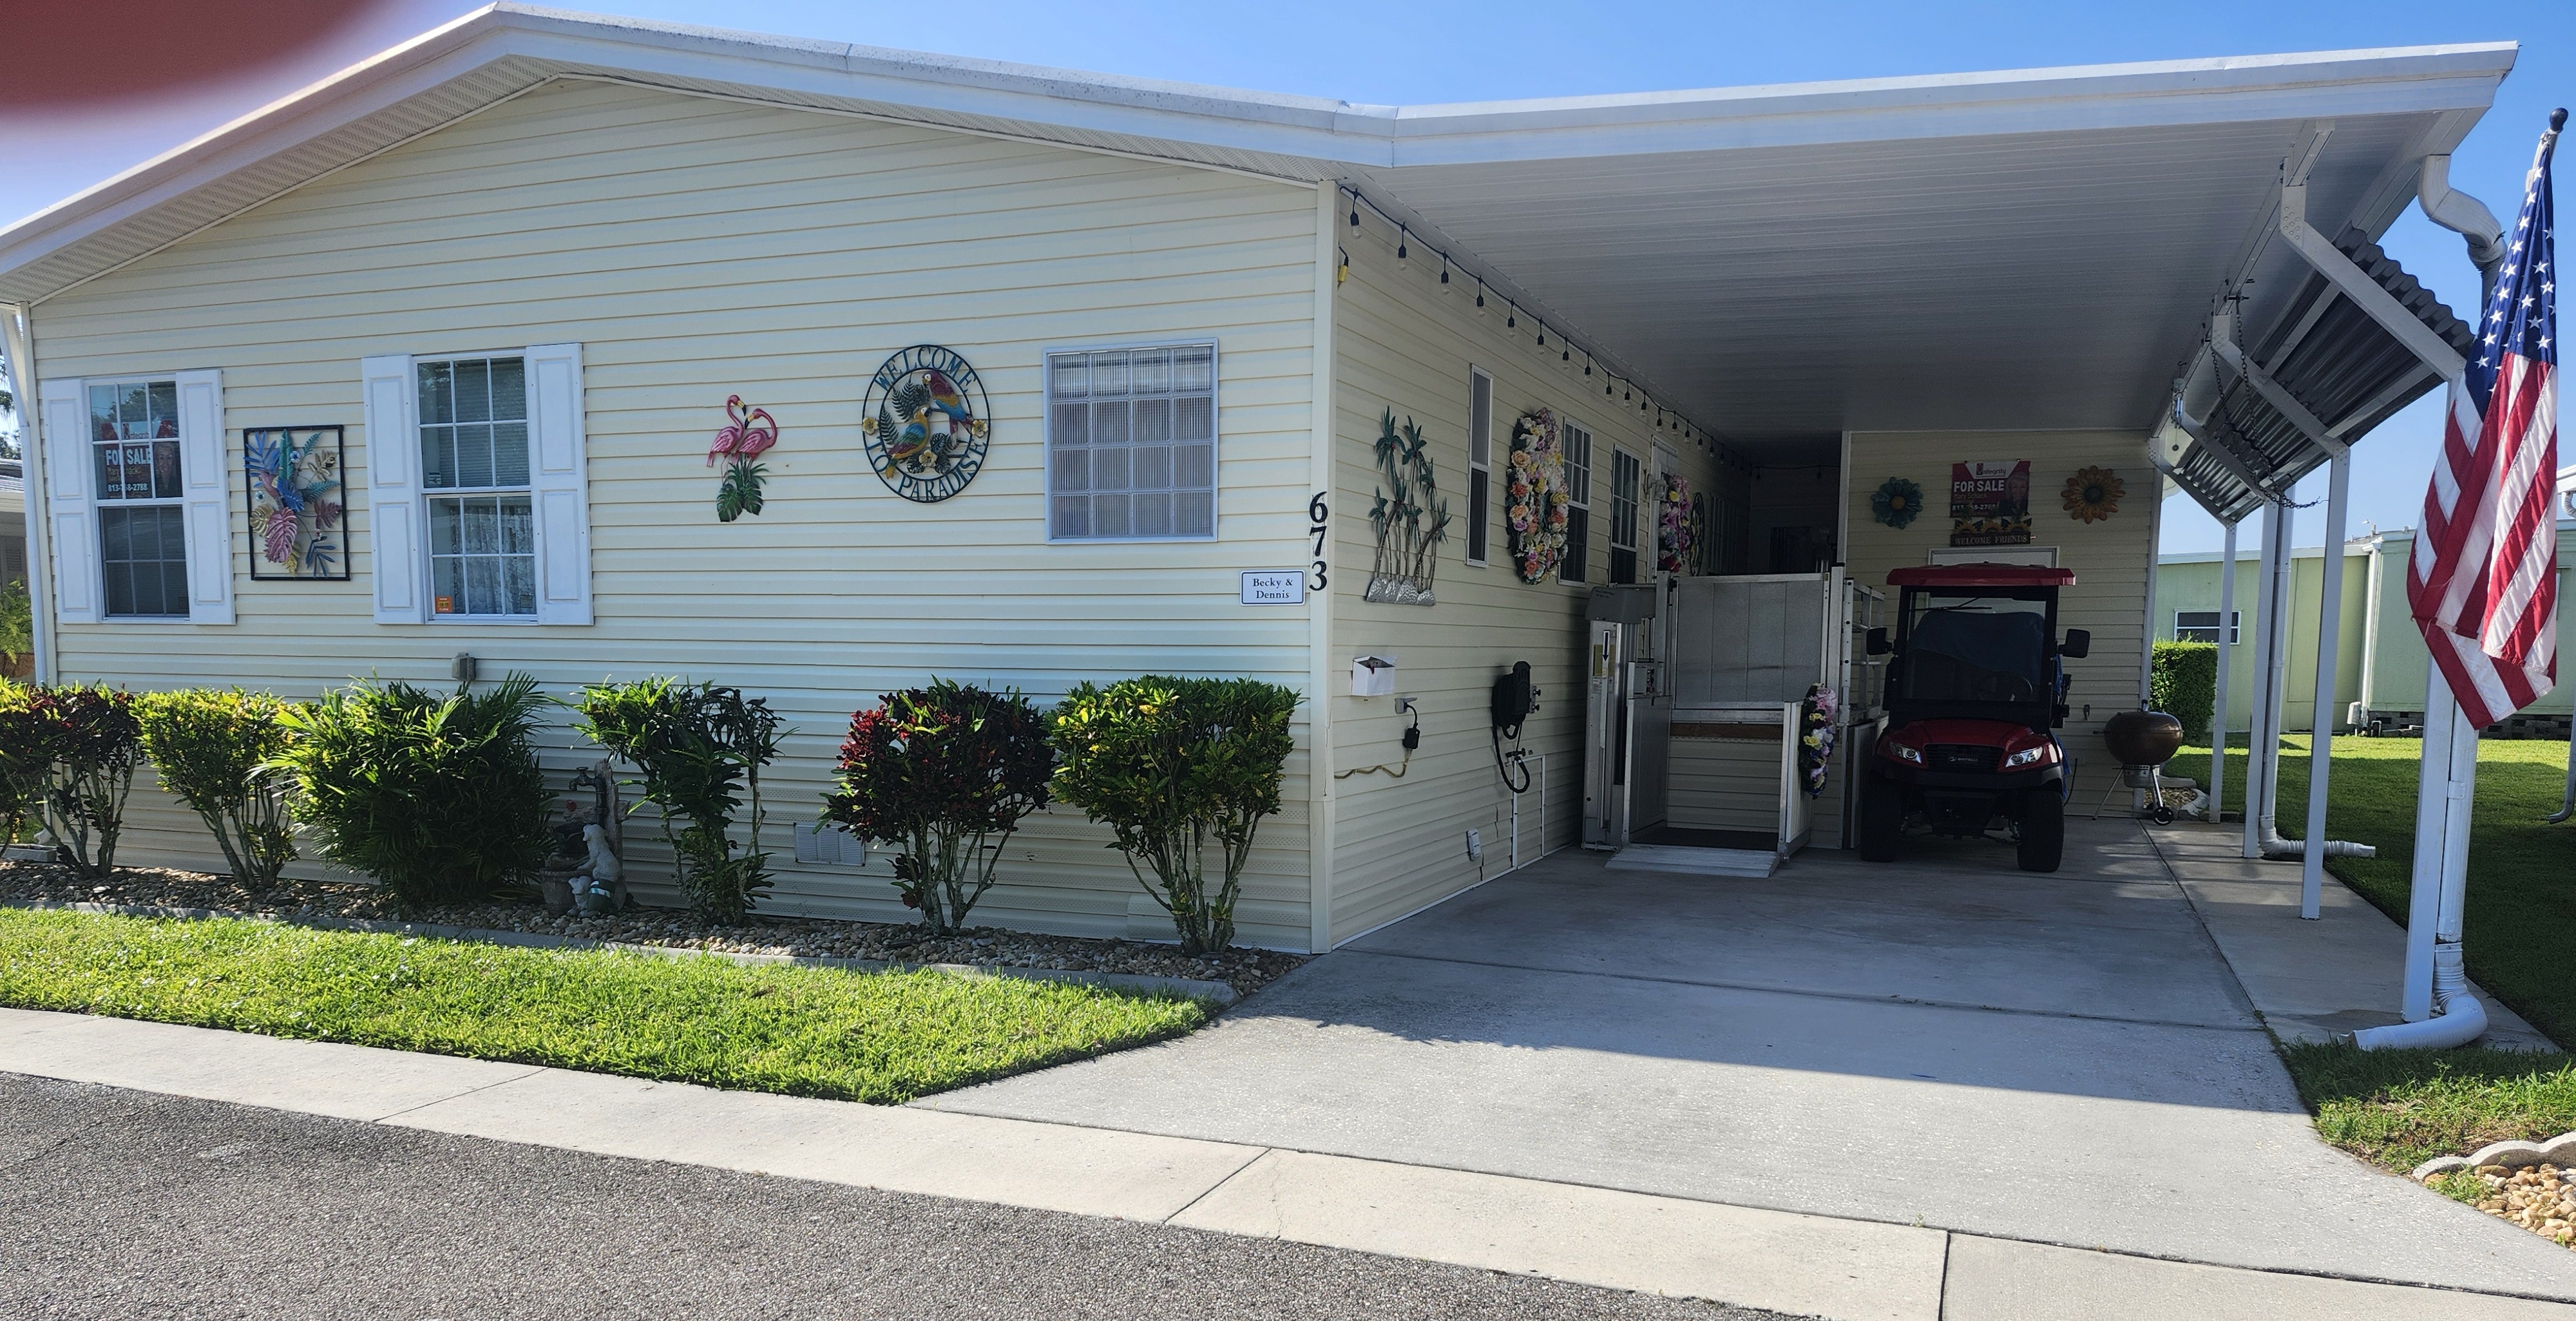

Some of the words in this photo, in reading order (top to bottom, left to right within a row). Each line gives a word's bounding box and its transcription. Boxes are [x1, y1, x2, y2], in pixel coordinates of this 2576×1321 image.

[873, 346, 977, 392] WELCOME
[127, 448, 152, 465] SALE
[866, 436, 890, 473] TO
[897, 439, 987, 501] PARADISE
[1954, 481, 1974, 492] FOR
[1977, 480, 2004, 491] SALE
[1309, 491, 1328, 591] 673
[1954, 536, 1991, 545] WELCOME
[1995, 535, 2027, 543] FRIENDS
[1253, 578, 1282, 589] Becky
[1256, 590, 1290, 598] Dennis
